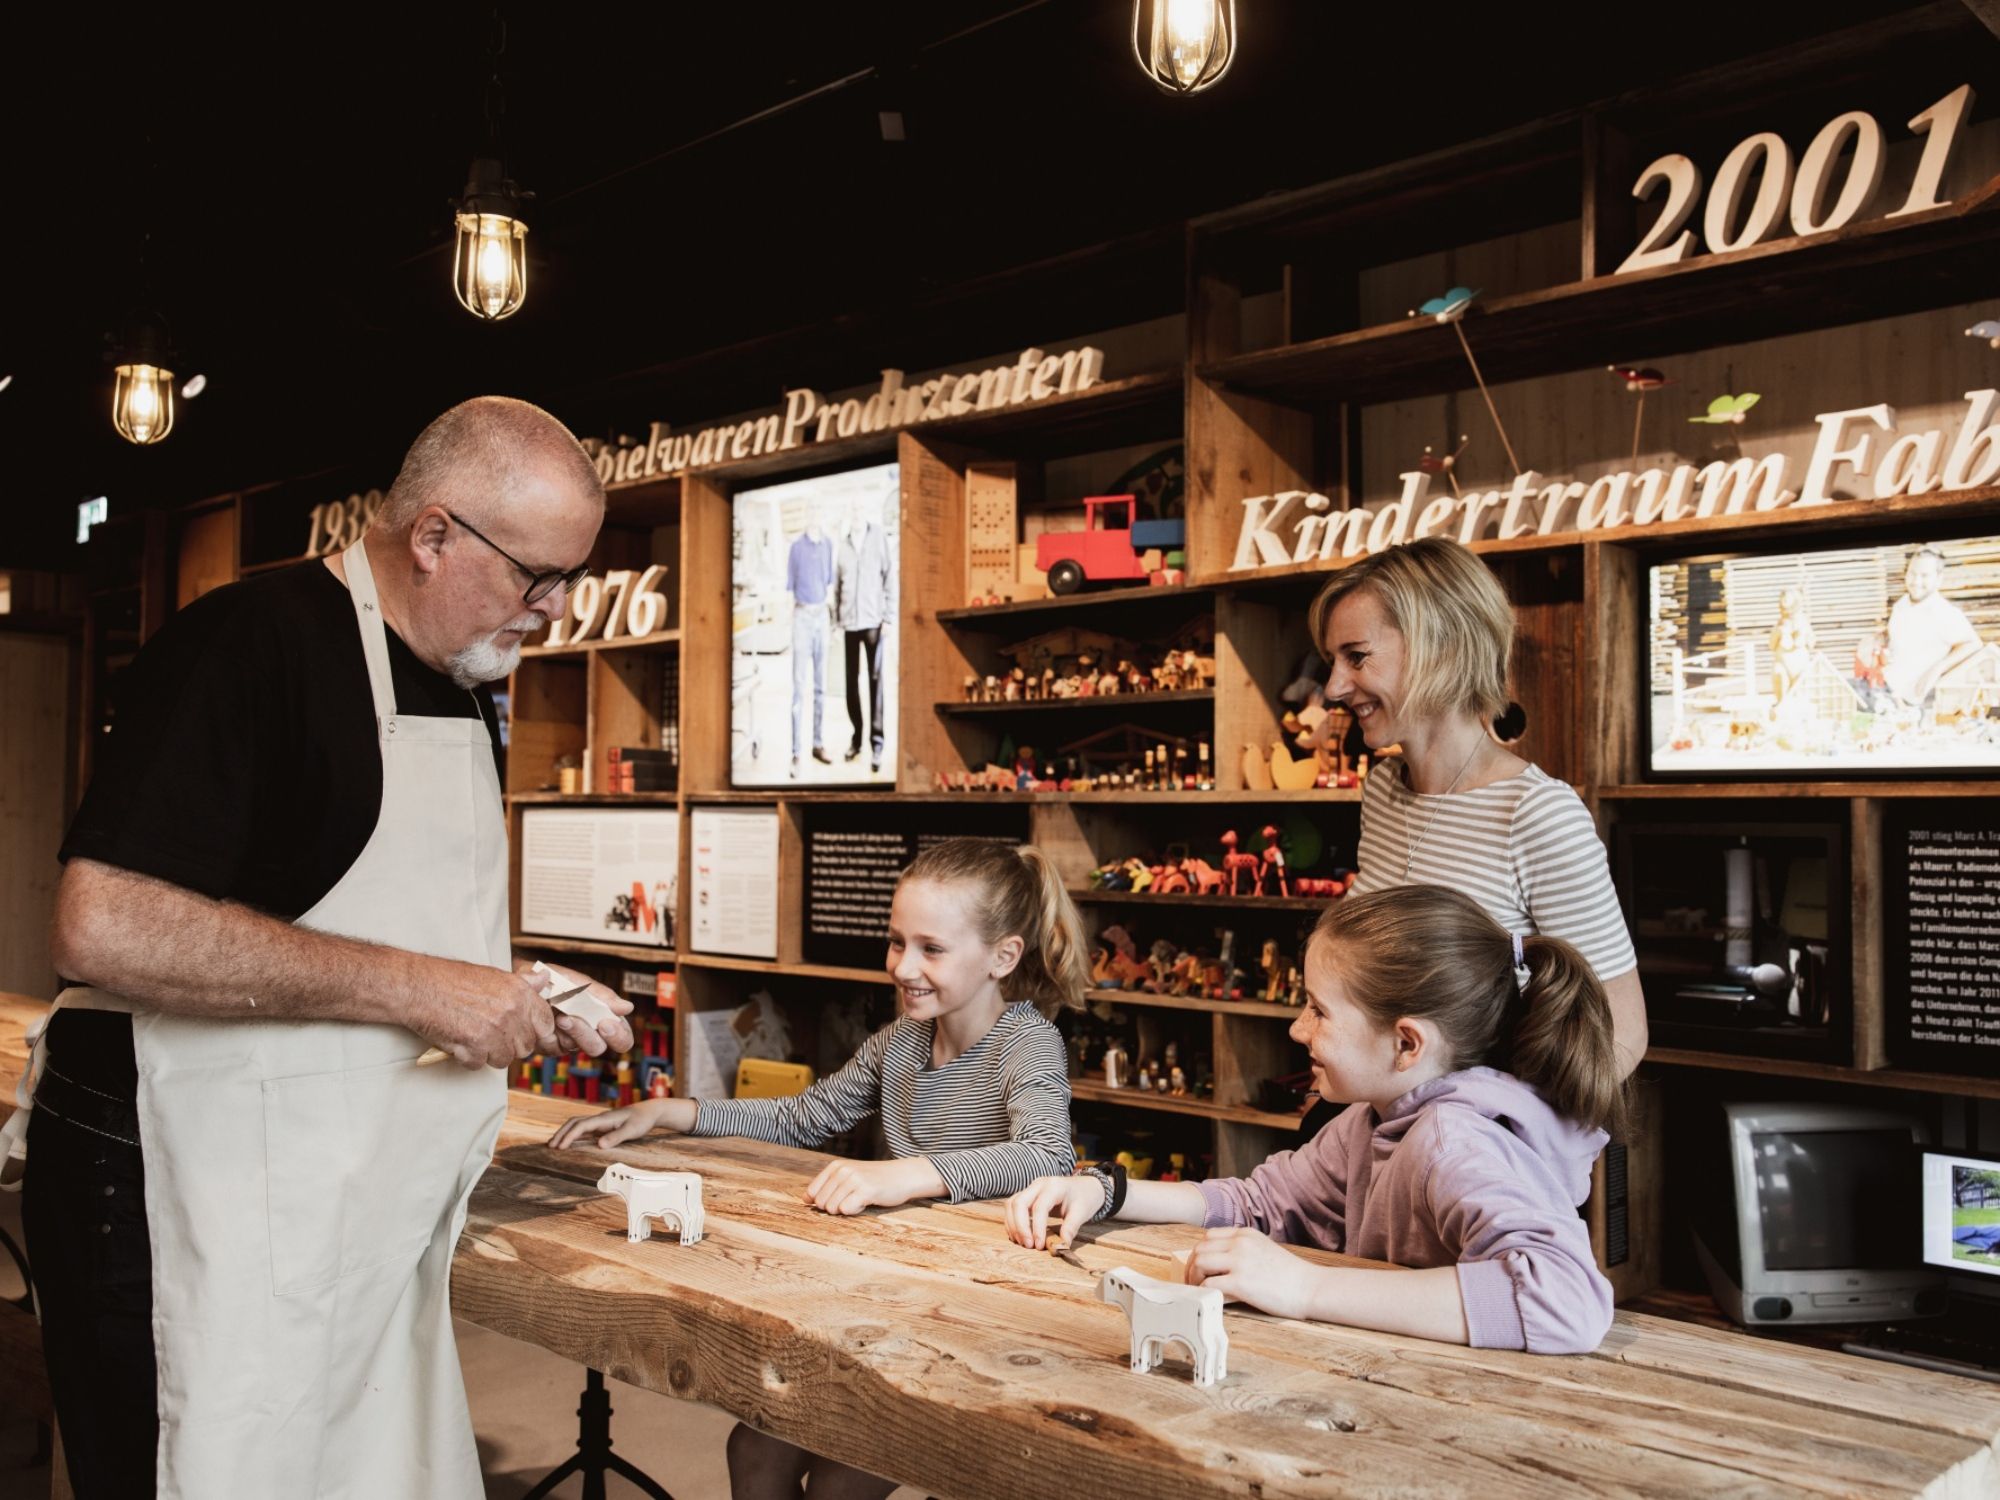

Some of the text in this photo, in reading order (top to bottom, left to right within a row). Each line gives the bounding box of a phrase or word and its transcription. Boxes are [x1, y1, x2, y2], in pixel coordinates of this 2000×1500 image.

[1614, 83, 1974, 275] 2001
[1227, 388, 2000, 572] KindertraumFab
[1909, 830, 1930, 840] 2001
[1937, 892, 1952, 902] und
[1934, 954, 1949, 964] den
[1951, 956, 1977, 965] ersten
[1910, 968, 1926, 978] und
[1911, 999, 1925, 1008] das
